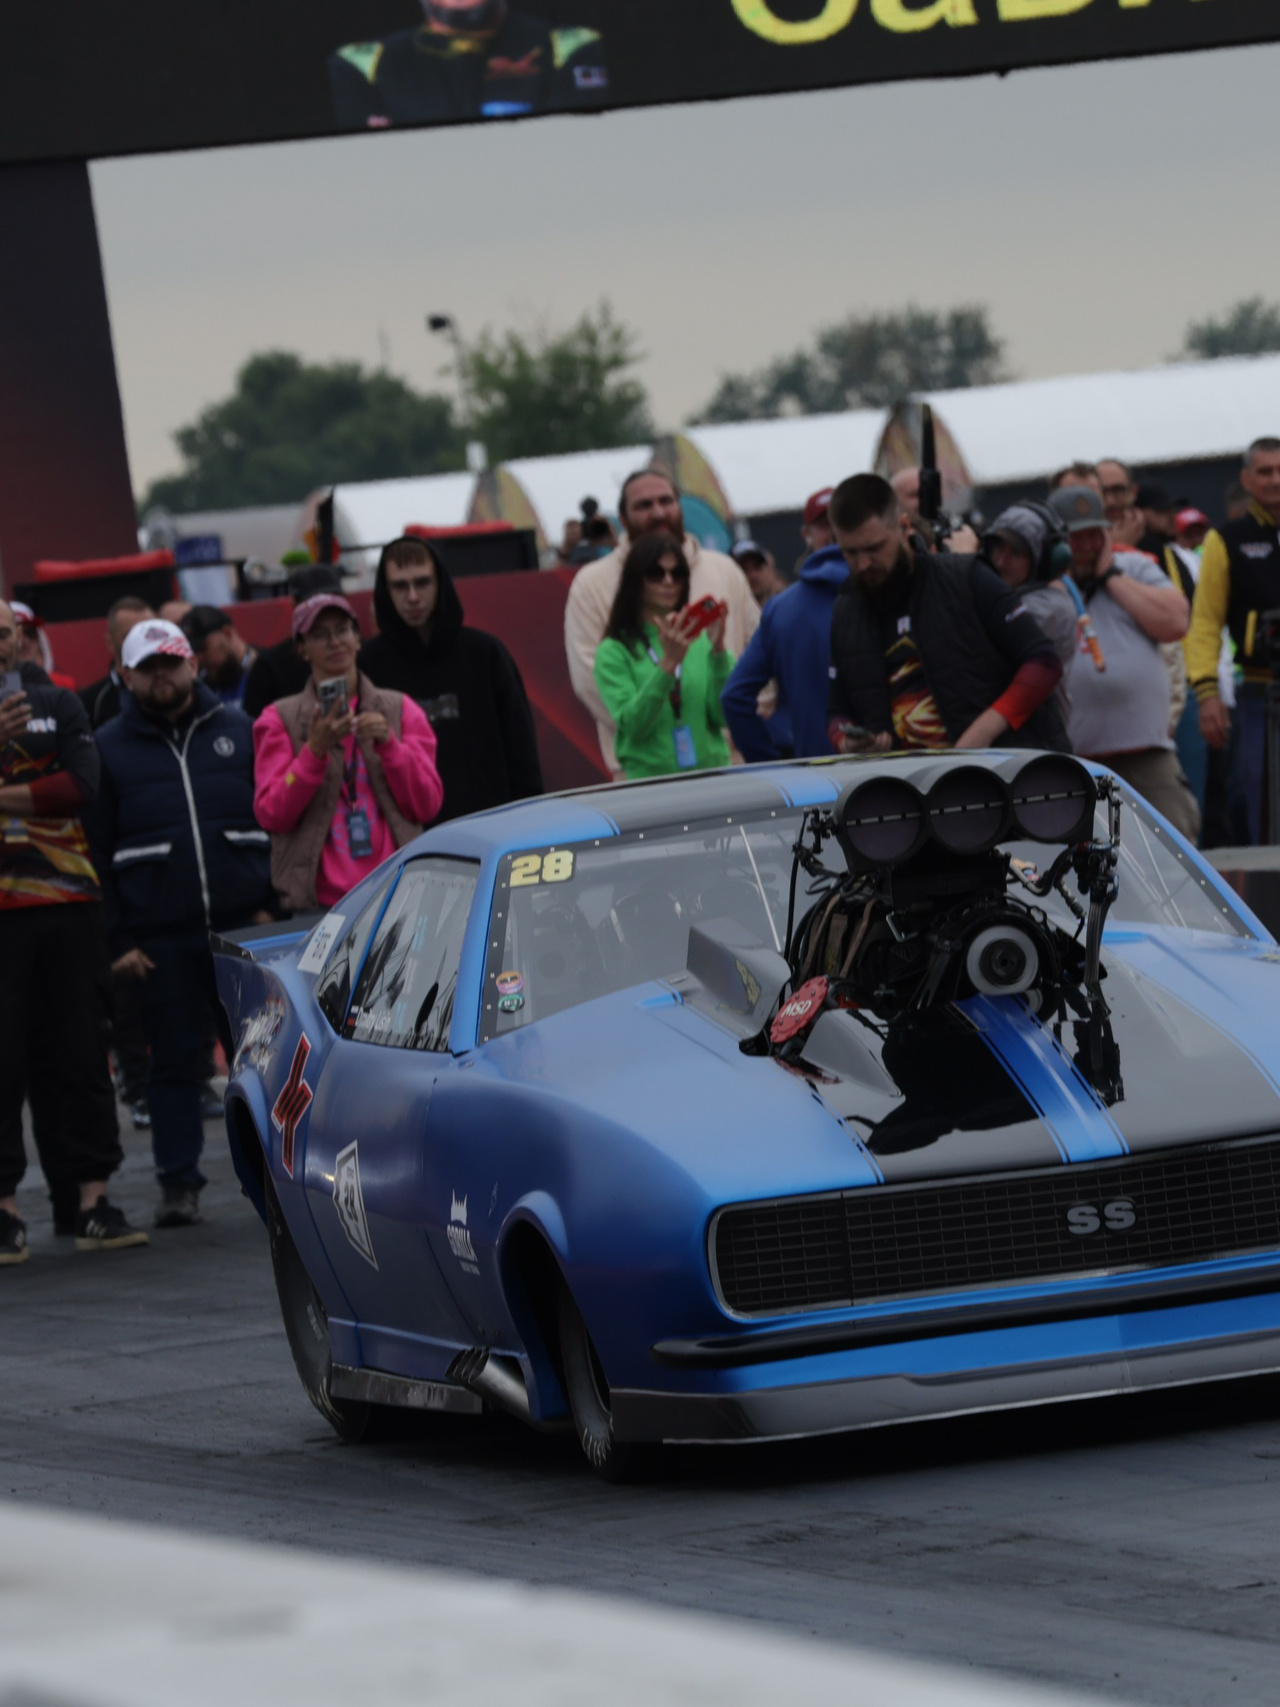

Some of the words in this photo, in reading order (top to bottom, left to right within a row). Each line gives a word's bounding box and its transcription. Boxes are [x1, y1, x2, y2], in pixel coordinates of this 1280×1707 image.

[509, 849, 574, 888] 28
[780, 999, 813, 1019] MSD
[1066, 1200, 1137, 1235] SS
[446, 1223, 478, 1263] GORILLA
